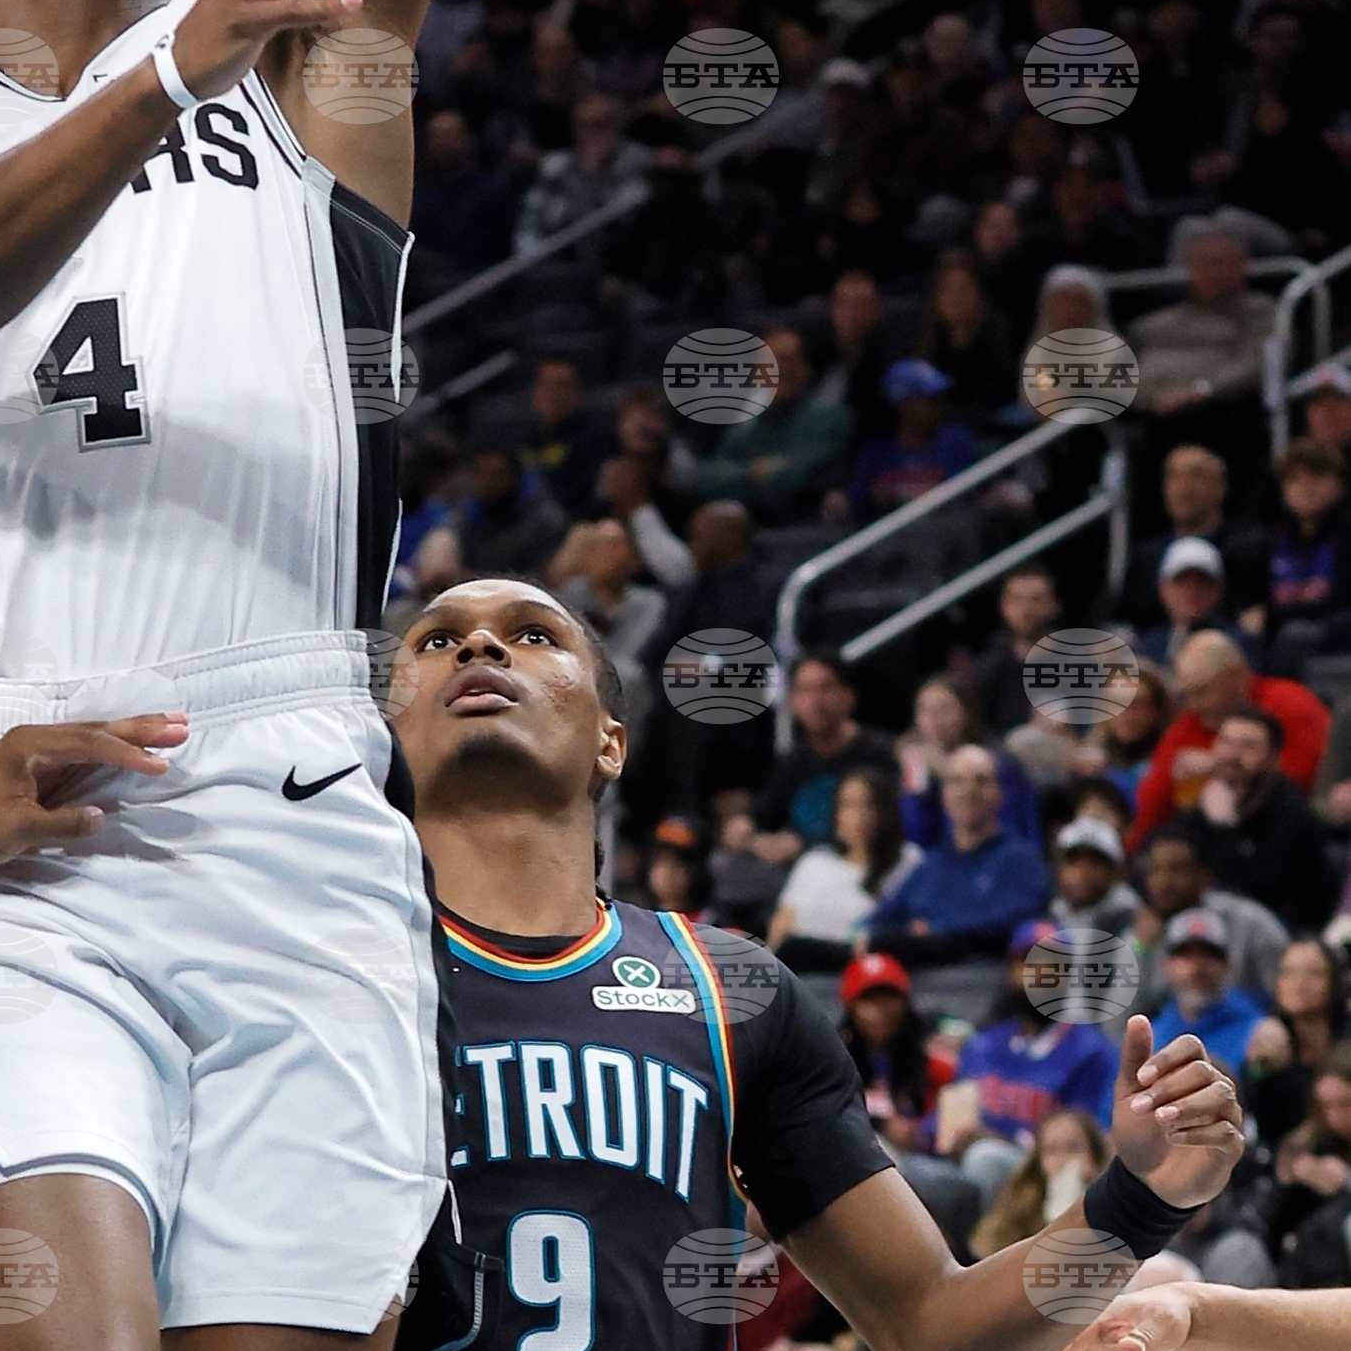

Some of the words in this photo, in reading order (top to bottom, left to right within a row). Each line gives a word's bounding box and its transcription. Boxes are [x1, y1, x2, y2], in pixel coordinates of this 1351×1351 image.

[26, 291, 151, 452] 4
[596, 989, 692, 1009] StockX
[451, 1040, 709, 1203] TROIT
